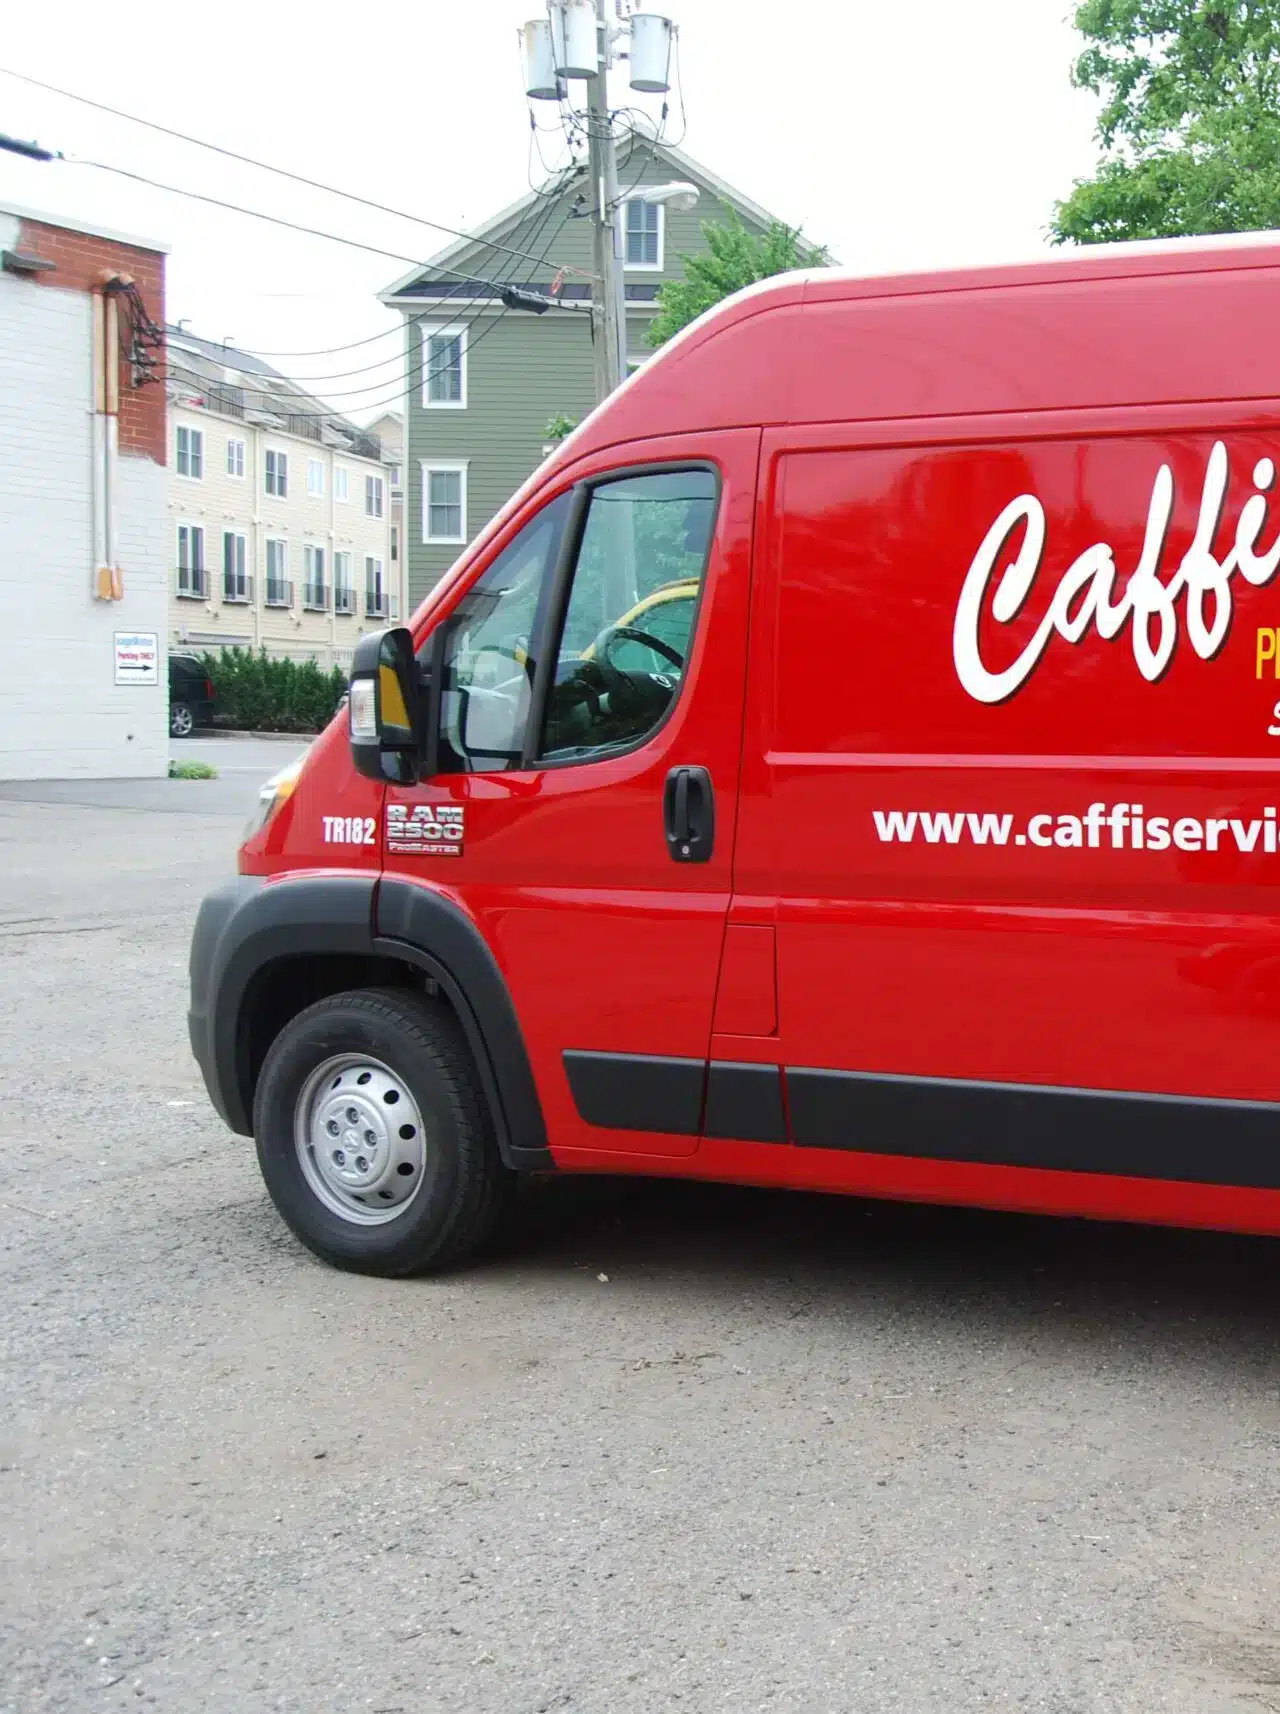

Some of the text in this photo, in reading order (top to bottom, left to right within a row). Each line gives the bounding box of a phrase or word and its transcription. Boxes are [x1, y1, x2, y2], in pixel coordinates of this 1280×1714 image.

[387, 804, 464, 822] RAM
[322, 816, 376, 844] TR182
[387, 822, 464, 841] 2500
